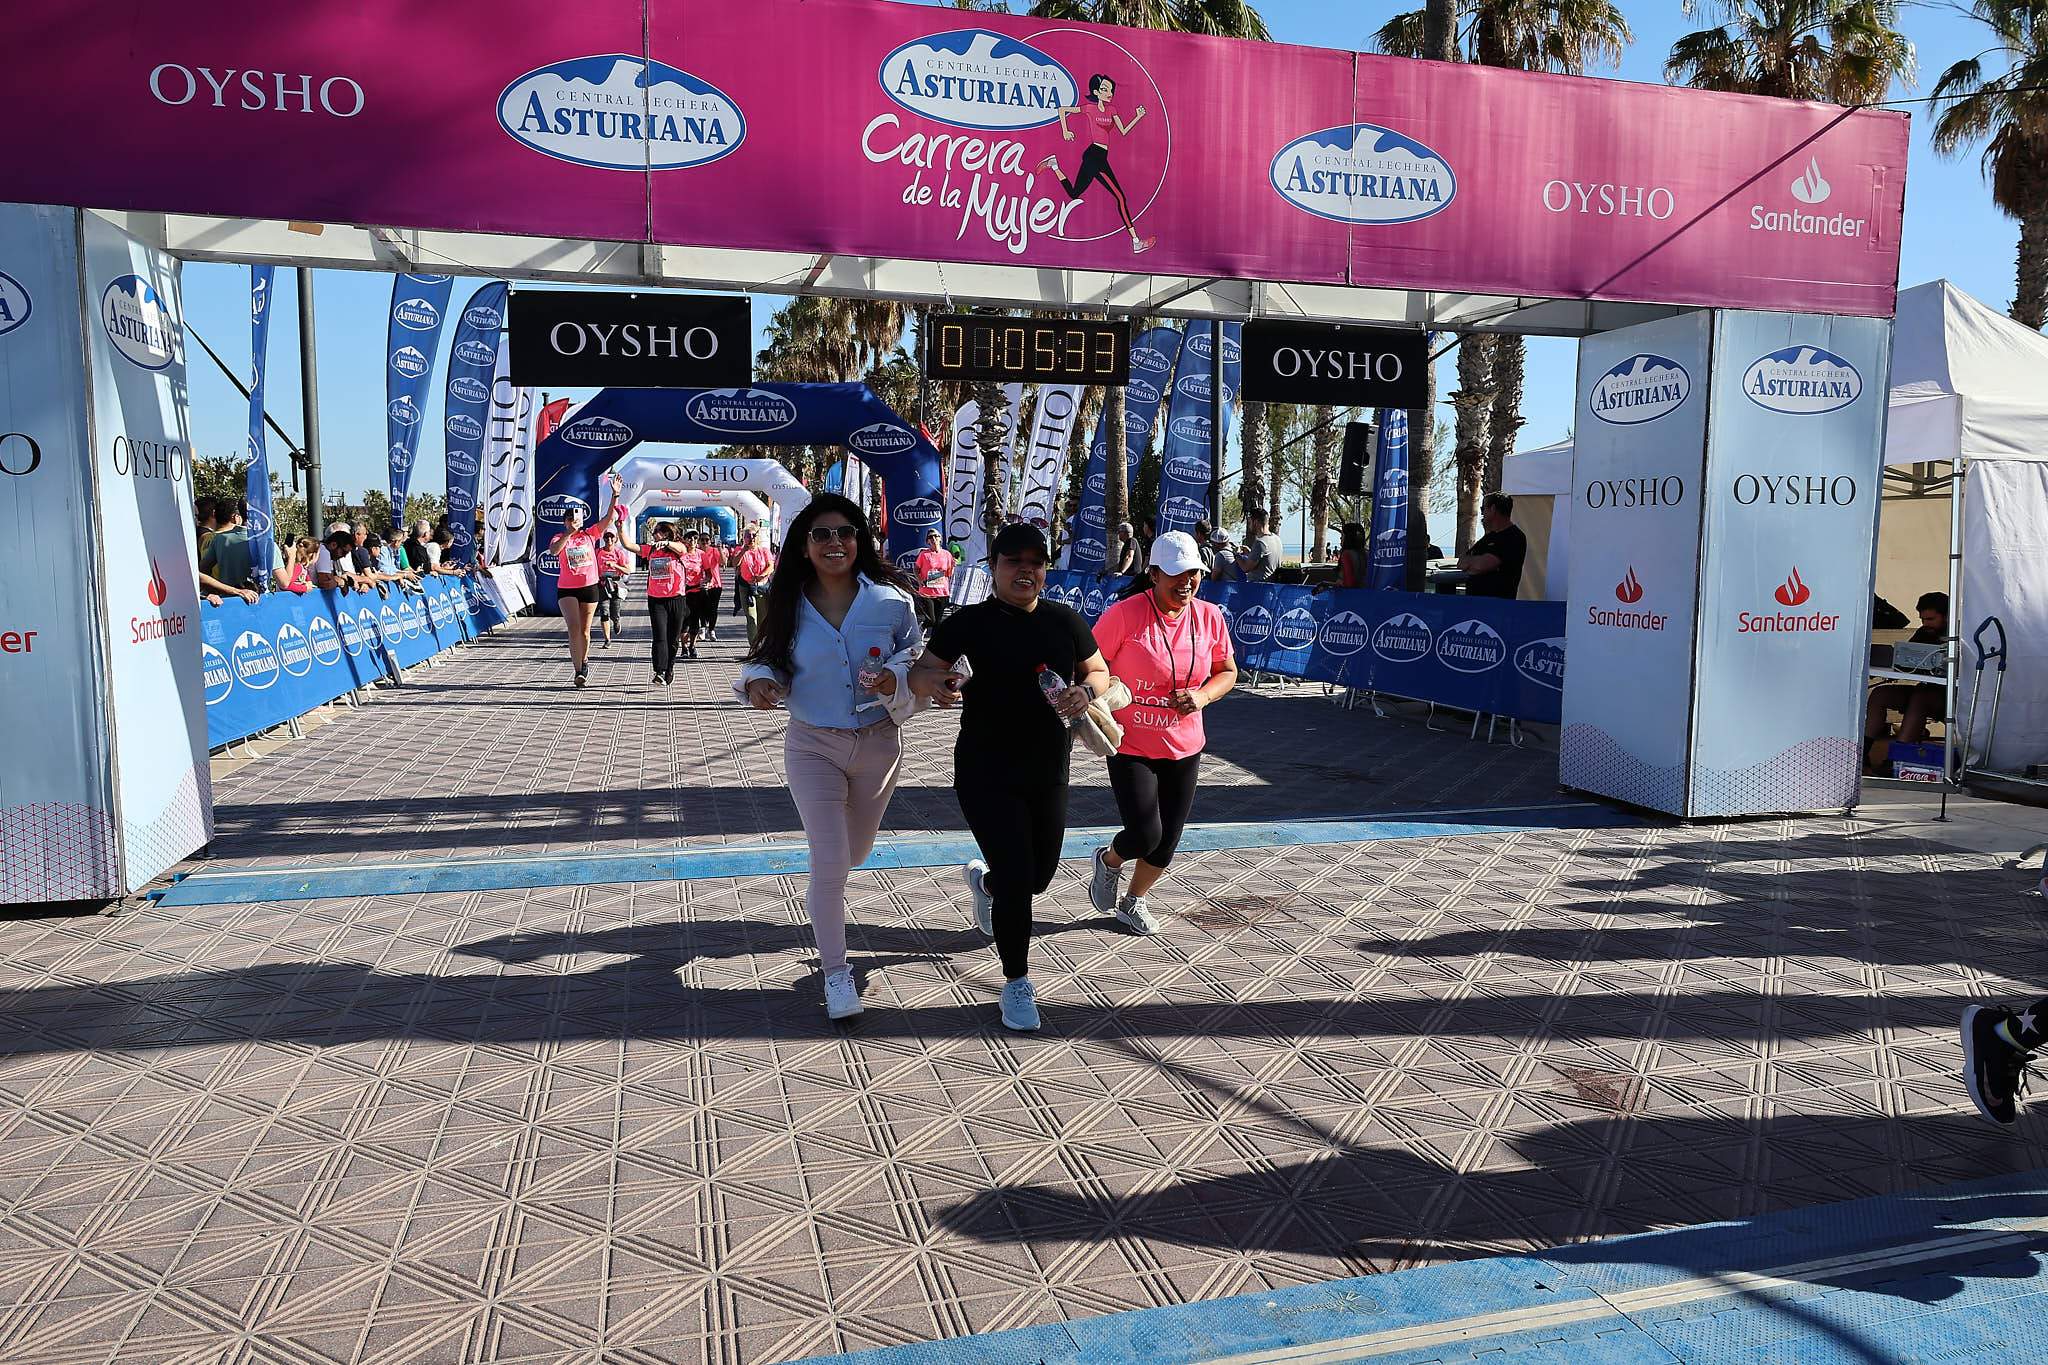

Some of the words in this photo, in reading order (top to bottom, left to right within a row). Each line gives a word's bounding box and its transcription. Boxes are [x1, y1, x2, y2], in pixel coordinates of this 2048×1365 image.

[895, 58, 1062, 110] ASTURIANA
[926, 59, 989, 74] CENTRAL
[995, 65, 1058, 81] LECHERA
[149, 63, 365, 117] OYSHO
[556, 89, 634, 106] CENTRAL
[642, 97, 720, 112] LECHERA
[517, 89, 728, 146] ASTURIANA
[861, 112, 1025, 175] Carrera
[1284, 154, 1442, 202] ASTURIANA
[1314, 154, 1372, 168] CENTRAL
[1378, 161, 1438, 173] LECHERA
[902, 171, 933, 206] de
[940, 171, 961, 208] la
[956, 172, 1085, 255] Mujer
[1542, 179, 1676, 220] OYSHO
[1750, 205, 1865, 237] Santander
[109, 297, 173, 354] ASTURIANA
[550, 321, 719, 360] OYSHO
[942, 325, 1115, 373] 01:05:33
[1272, 347, 1403, 382] OYSHO
[1769, 368, 1809, 377] CENTRAL
[1811, 370, 1851, 378] LECHERA
[1610, 377, 1643, 390] CENTRAL
[1644, 373, 1680, 385] LECHERA
[1750, 369, 1853, 399] ASTURIANA
[694, 399, 789, 423] ASTURIANA
[711, 399, 747, 407] CENTRAL
[1595, 382, 1683, 412] ASTURIANA
[566, 427, 627, 442] ASTURIANA
[854, 434, 912, 447] ASTURIANA
[113, 435, 183, 482] OYSHO
[663, 464, 748, 483] OYSHO
[950, 425, 977, 541] OYSHO
[1586, 475, 1684, 509] OYSHO
[1733, 474, 1856, 506] OYSHO
[130, 611, 187, 644] Santander
[1275, 623, 1313, 641] ASTURIANA
[1587, 606, 1668, 631] Santander
[1737, 611, 1840, 633] Santander
[1322, 625, 1364, 646] ASTURIANA
[1374, 629, 1426, 653] ASTURIANA
[1439, 635, 1498, 664] ASTURIANA
[236, 655, 278, 678] ASTURIANA
[1133, 711, 1180, 727] SUMA
[1899, 769, 1929, 782] Carrera
